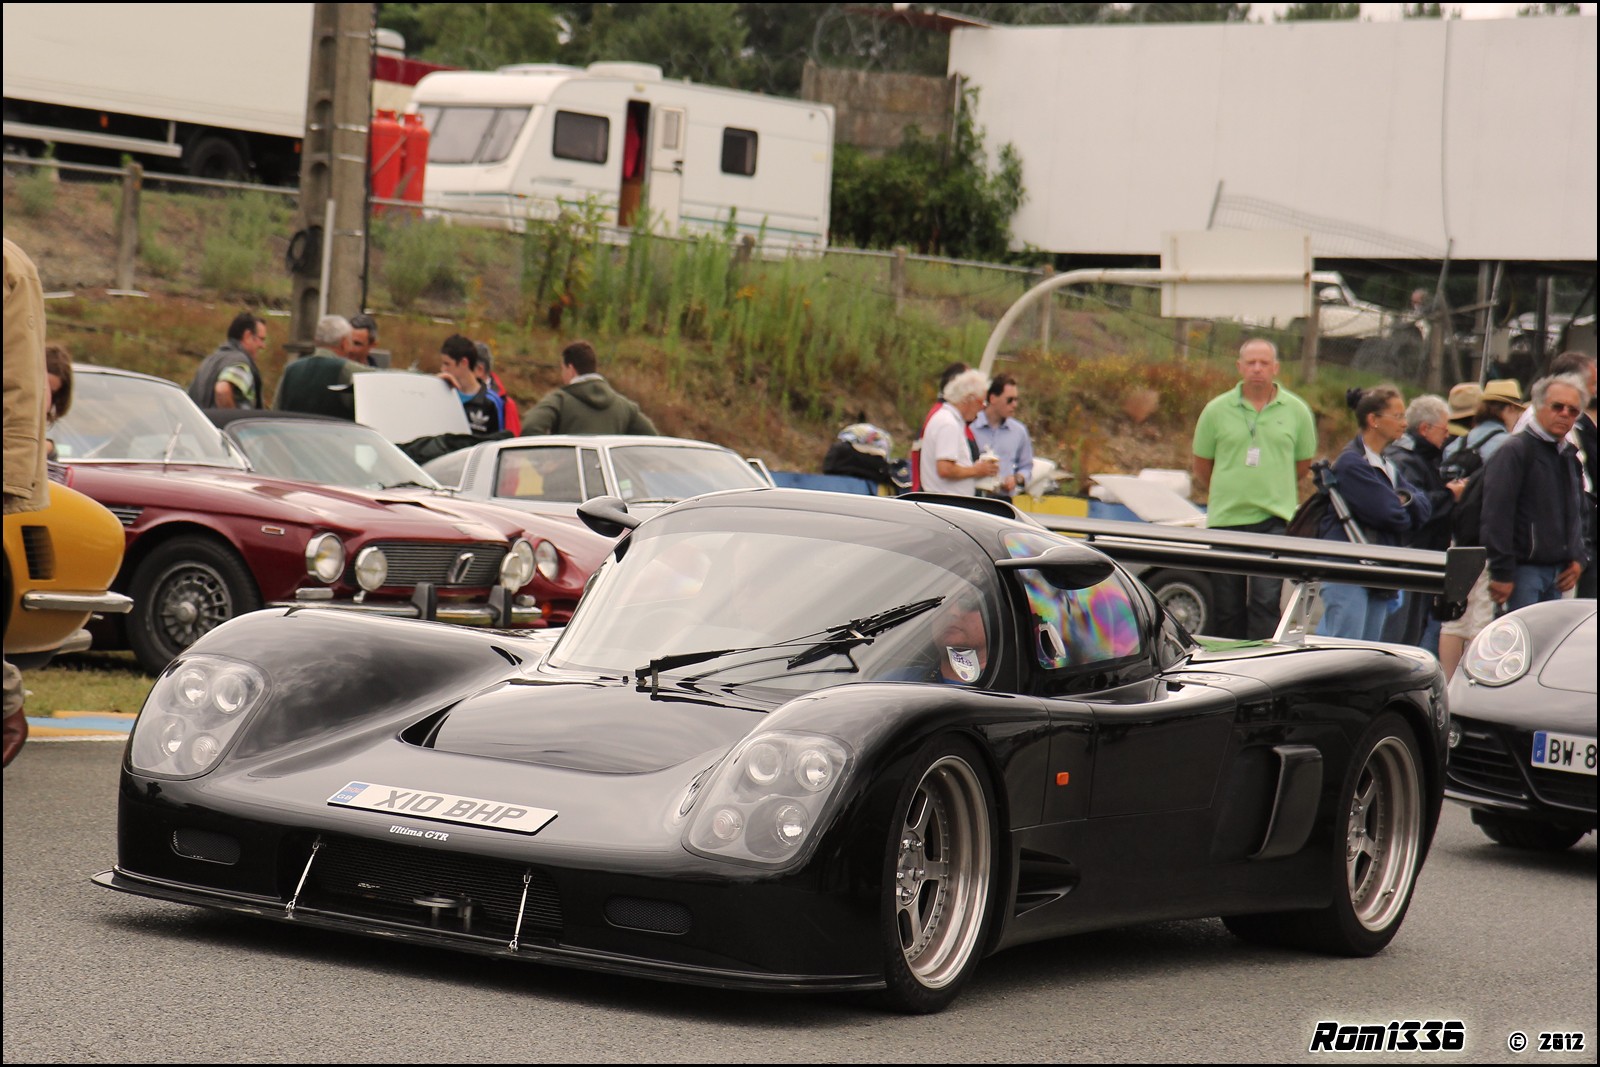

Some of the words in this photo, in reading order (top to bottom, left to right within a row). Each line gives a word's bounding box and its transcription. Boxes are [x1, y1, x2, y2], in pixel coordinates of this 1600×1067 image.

[374, 790, 444, 813] X10
[441, 800, 528, 824] BHP
[389, 825, 423, 837] Ultima
[424, 830, 450, 841] GTR
